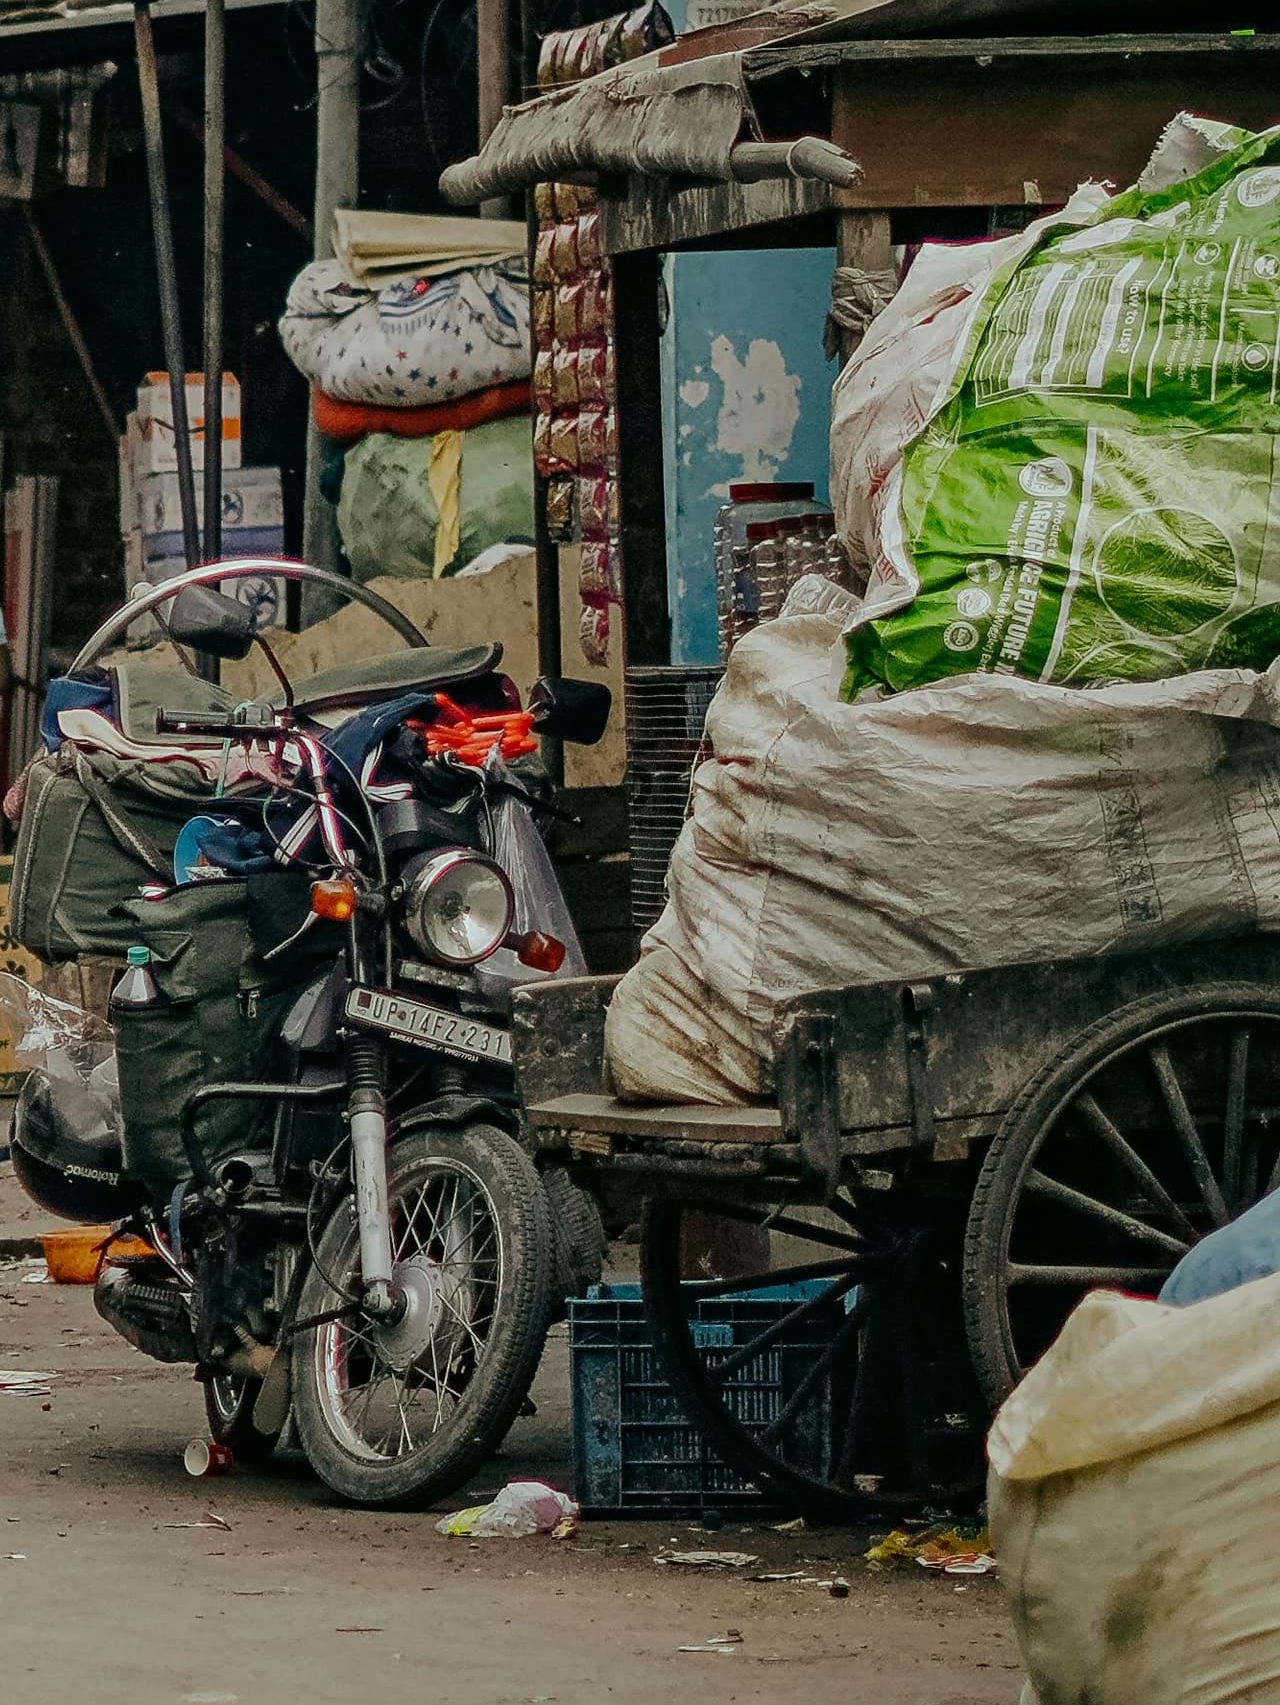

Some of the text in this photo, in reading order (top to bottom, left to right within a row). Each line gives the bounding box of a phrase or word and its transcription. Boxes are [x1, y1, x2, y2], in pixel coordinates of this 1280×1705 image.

[1116, 279, 1146, 354] How to use?
[1189, 373, 1199, 389] soil
[1047, 509, 1066, 548] Product
[999, 588, 1038, 661] FUTURE
